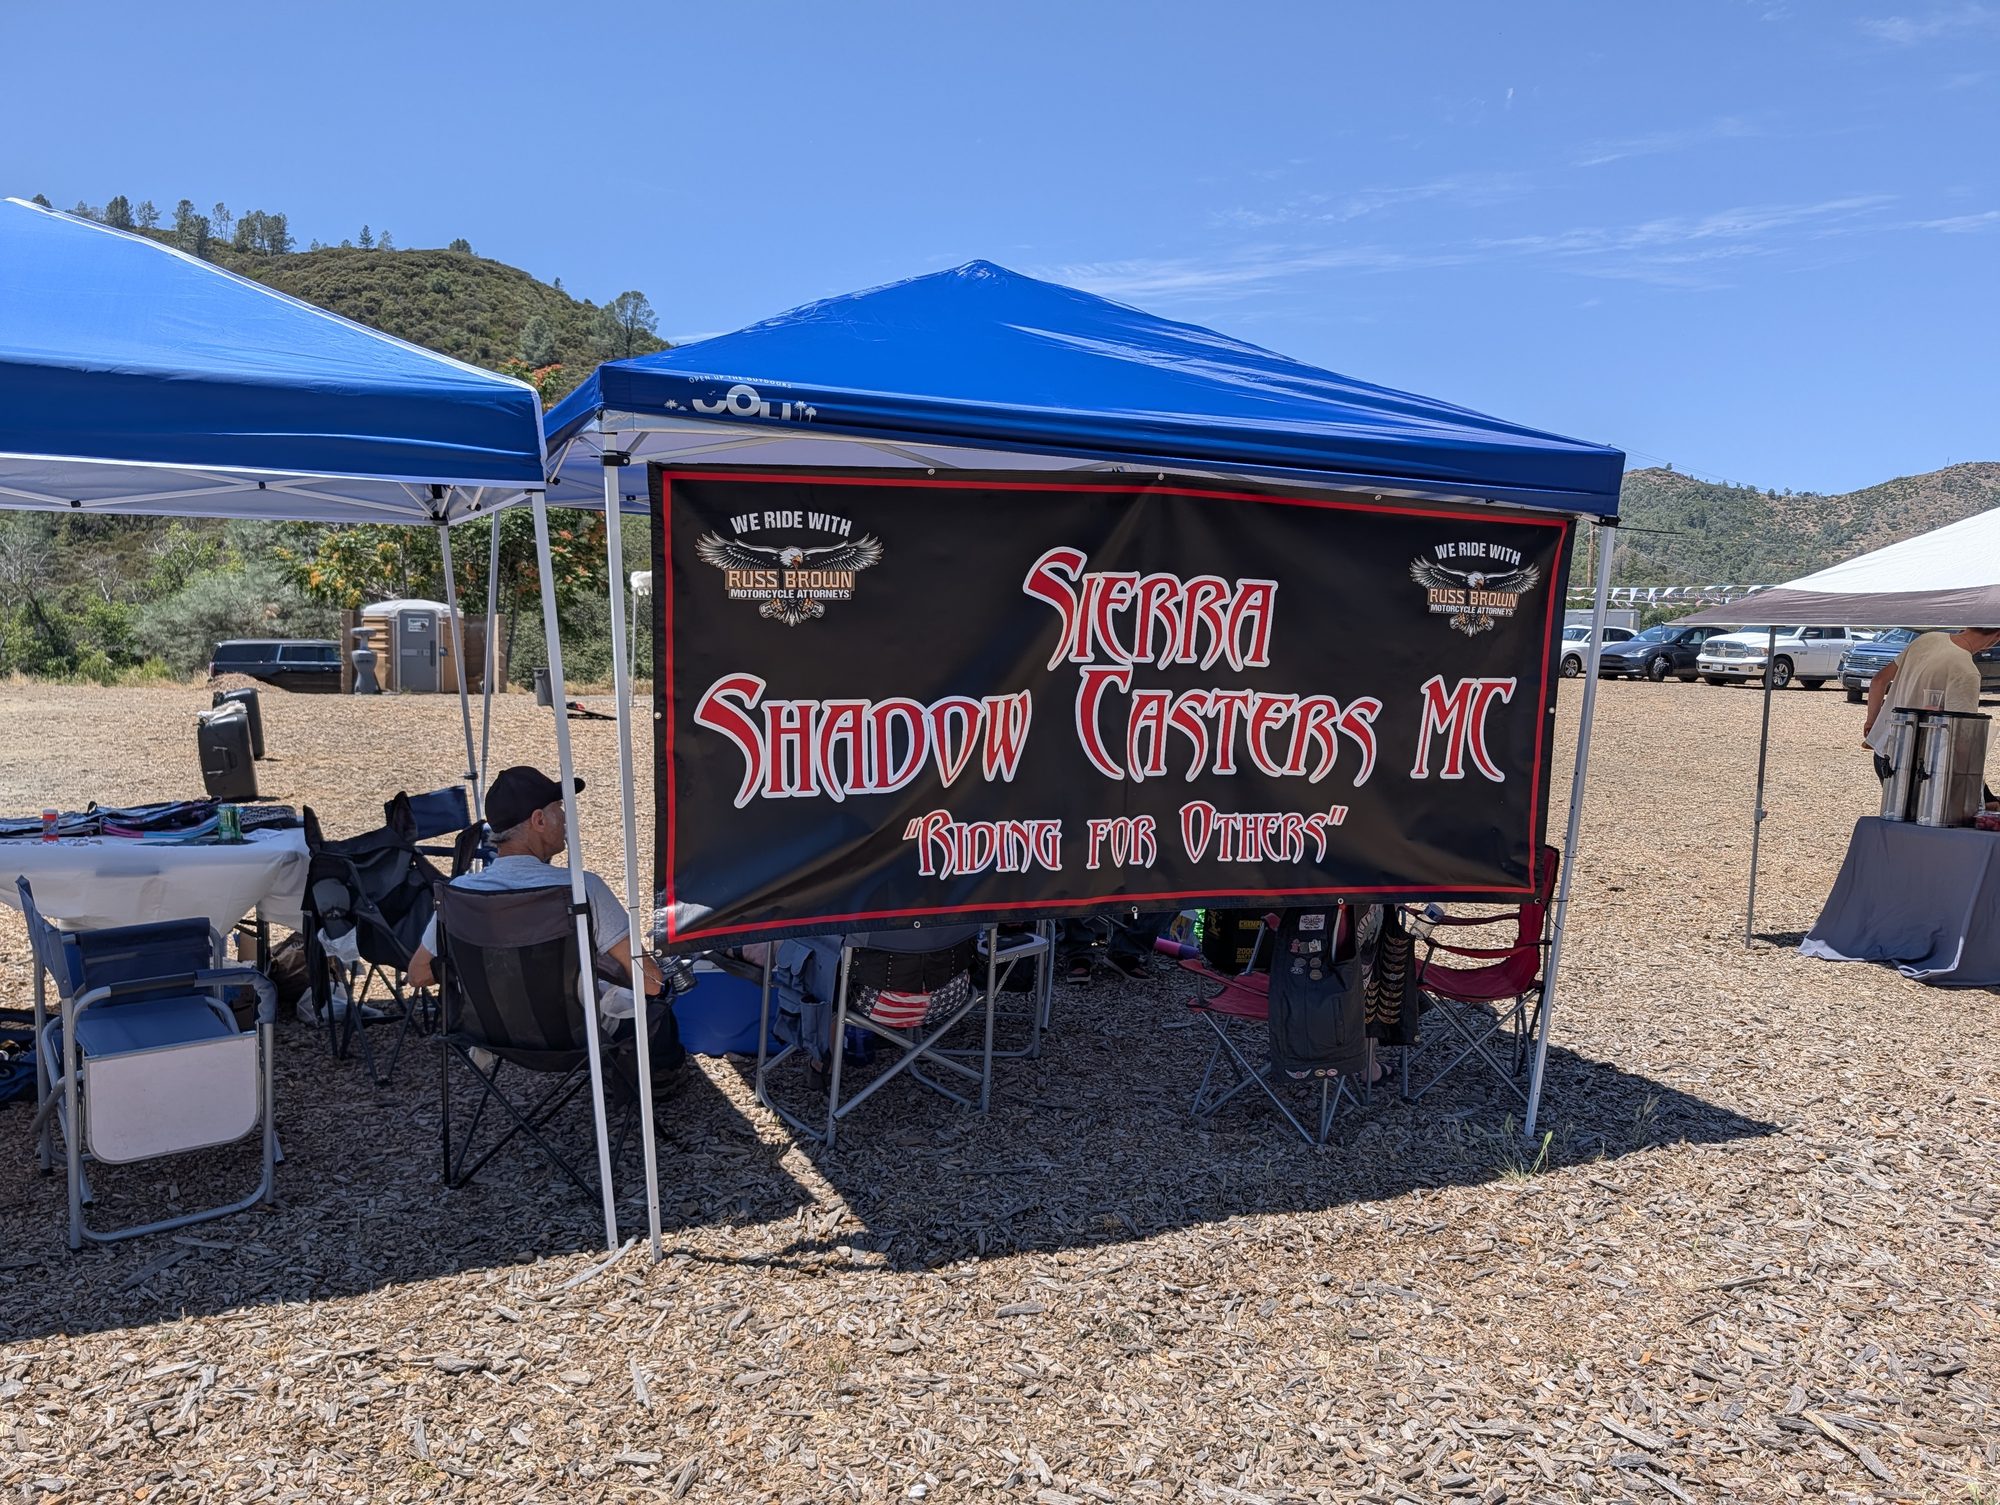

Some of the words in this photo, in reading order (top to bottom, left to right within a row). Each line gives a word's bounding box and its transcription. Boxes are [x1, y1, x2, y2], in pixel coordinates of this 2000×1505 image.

[688, 375, 711, 384] OPEN
[746, 376, 792, 389] OUTDOORS
[730, 512, 761, 535] WE
[764, 510, 803, 529] RIDE
[808, 511, 852, 537] WITH
[1434, 542, 1456, 560] WE
[1458, 541, 1487, 557] RIDE
[1489, 543, 1521, 566] WITH
[728, 570, 778, 588] RUSS
[784, 570, 852, 588] BROWN
[730, 589, 794, 599] MOTORCYCLE
[796, 589, 850, 599] ATTORNEYS
[1429, 588, 1465, 604] RUSS
[1470, 590, 1518, 608] BROWN
[1022, 546, 1279, 673] SIERRA
[1430, 604, 1476, 614] MOTORCYCLE
[1477, 606, 1513, 616] ATTORNEYS
[693, 672, 1032, 809] SHADOW
[1075, 664, 1383, 788] CASTERS
[1410, 674, 1517, 783] MC
[1086, 815, 1157, 870] FOR
